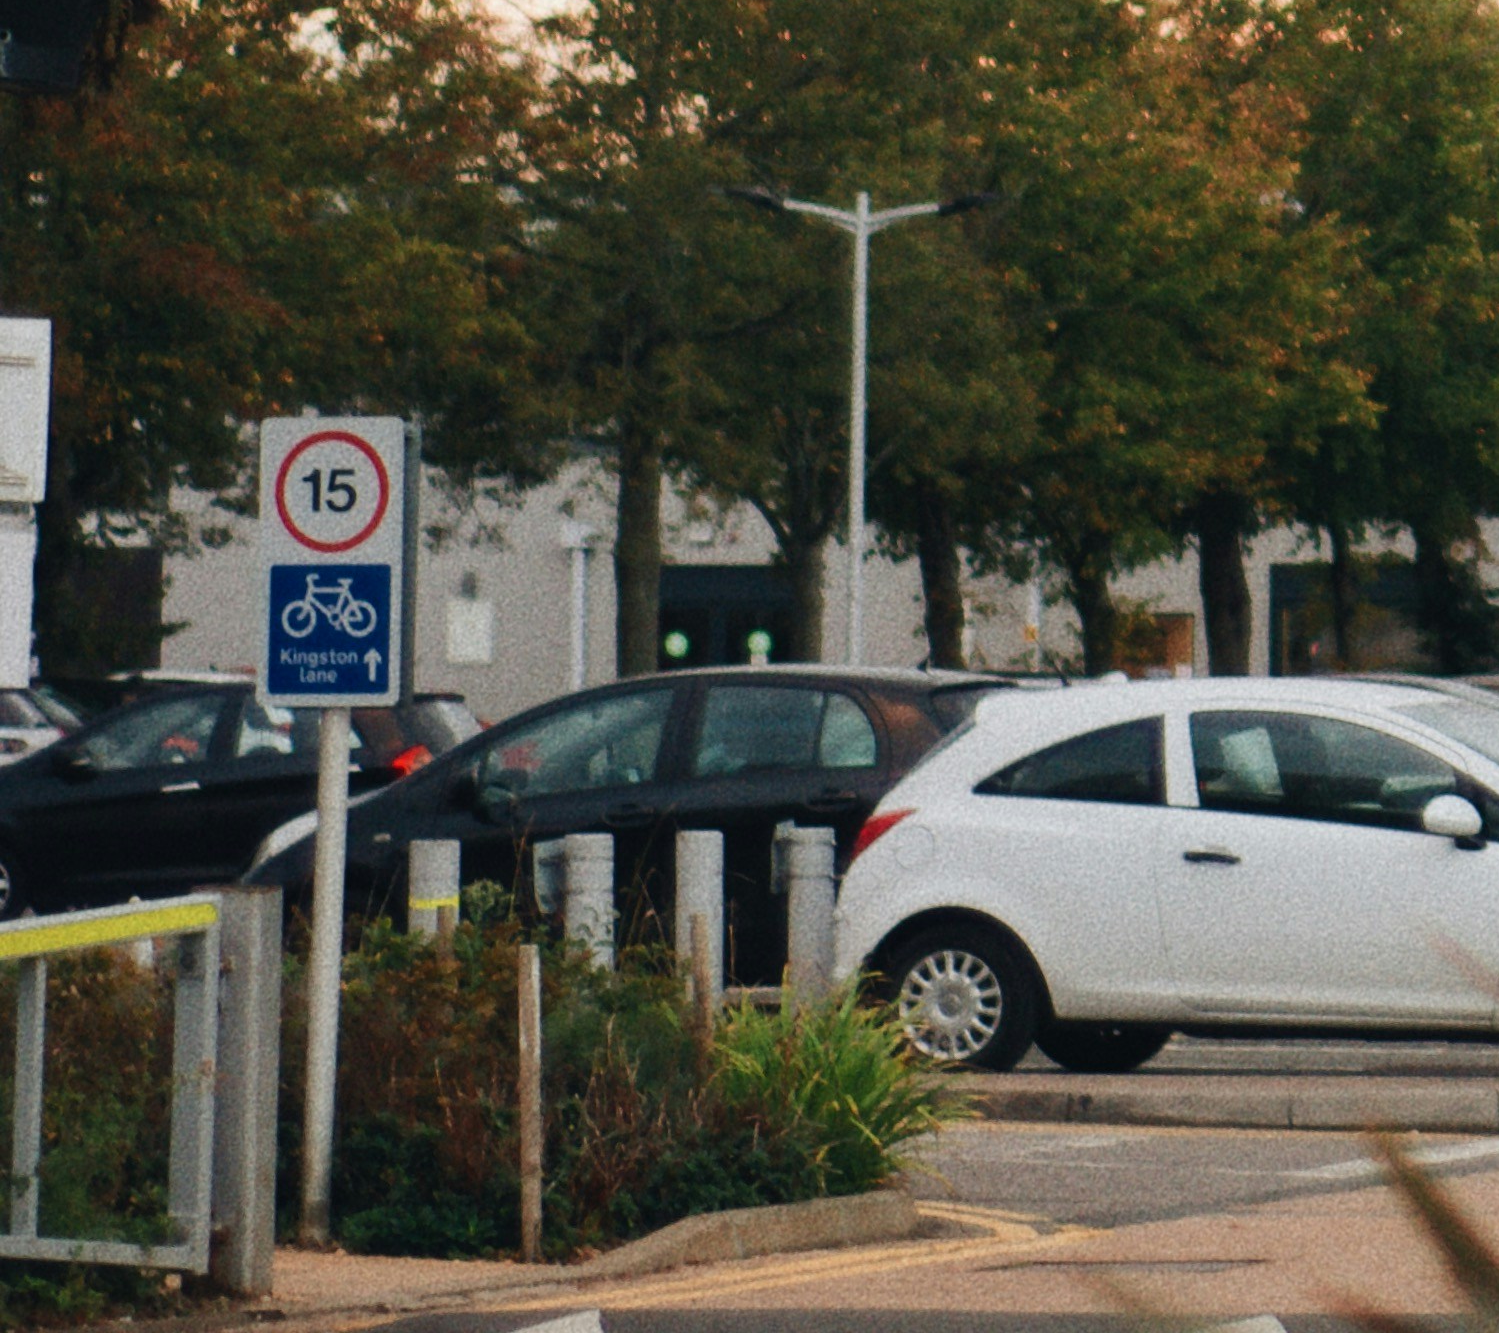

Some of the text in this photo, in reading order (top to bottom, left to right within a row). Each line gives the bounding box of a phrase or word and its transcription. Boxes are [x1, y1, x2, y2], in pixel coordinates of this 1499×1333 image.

[302, 468, 357, 513] 15
[280, 648, 358, 668] Kingston
[300, 666, 338, 683] lane
